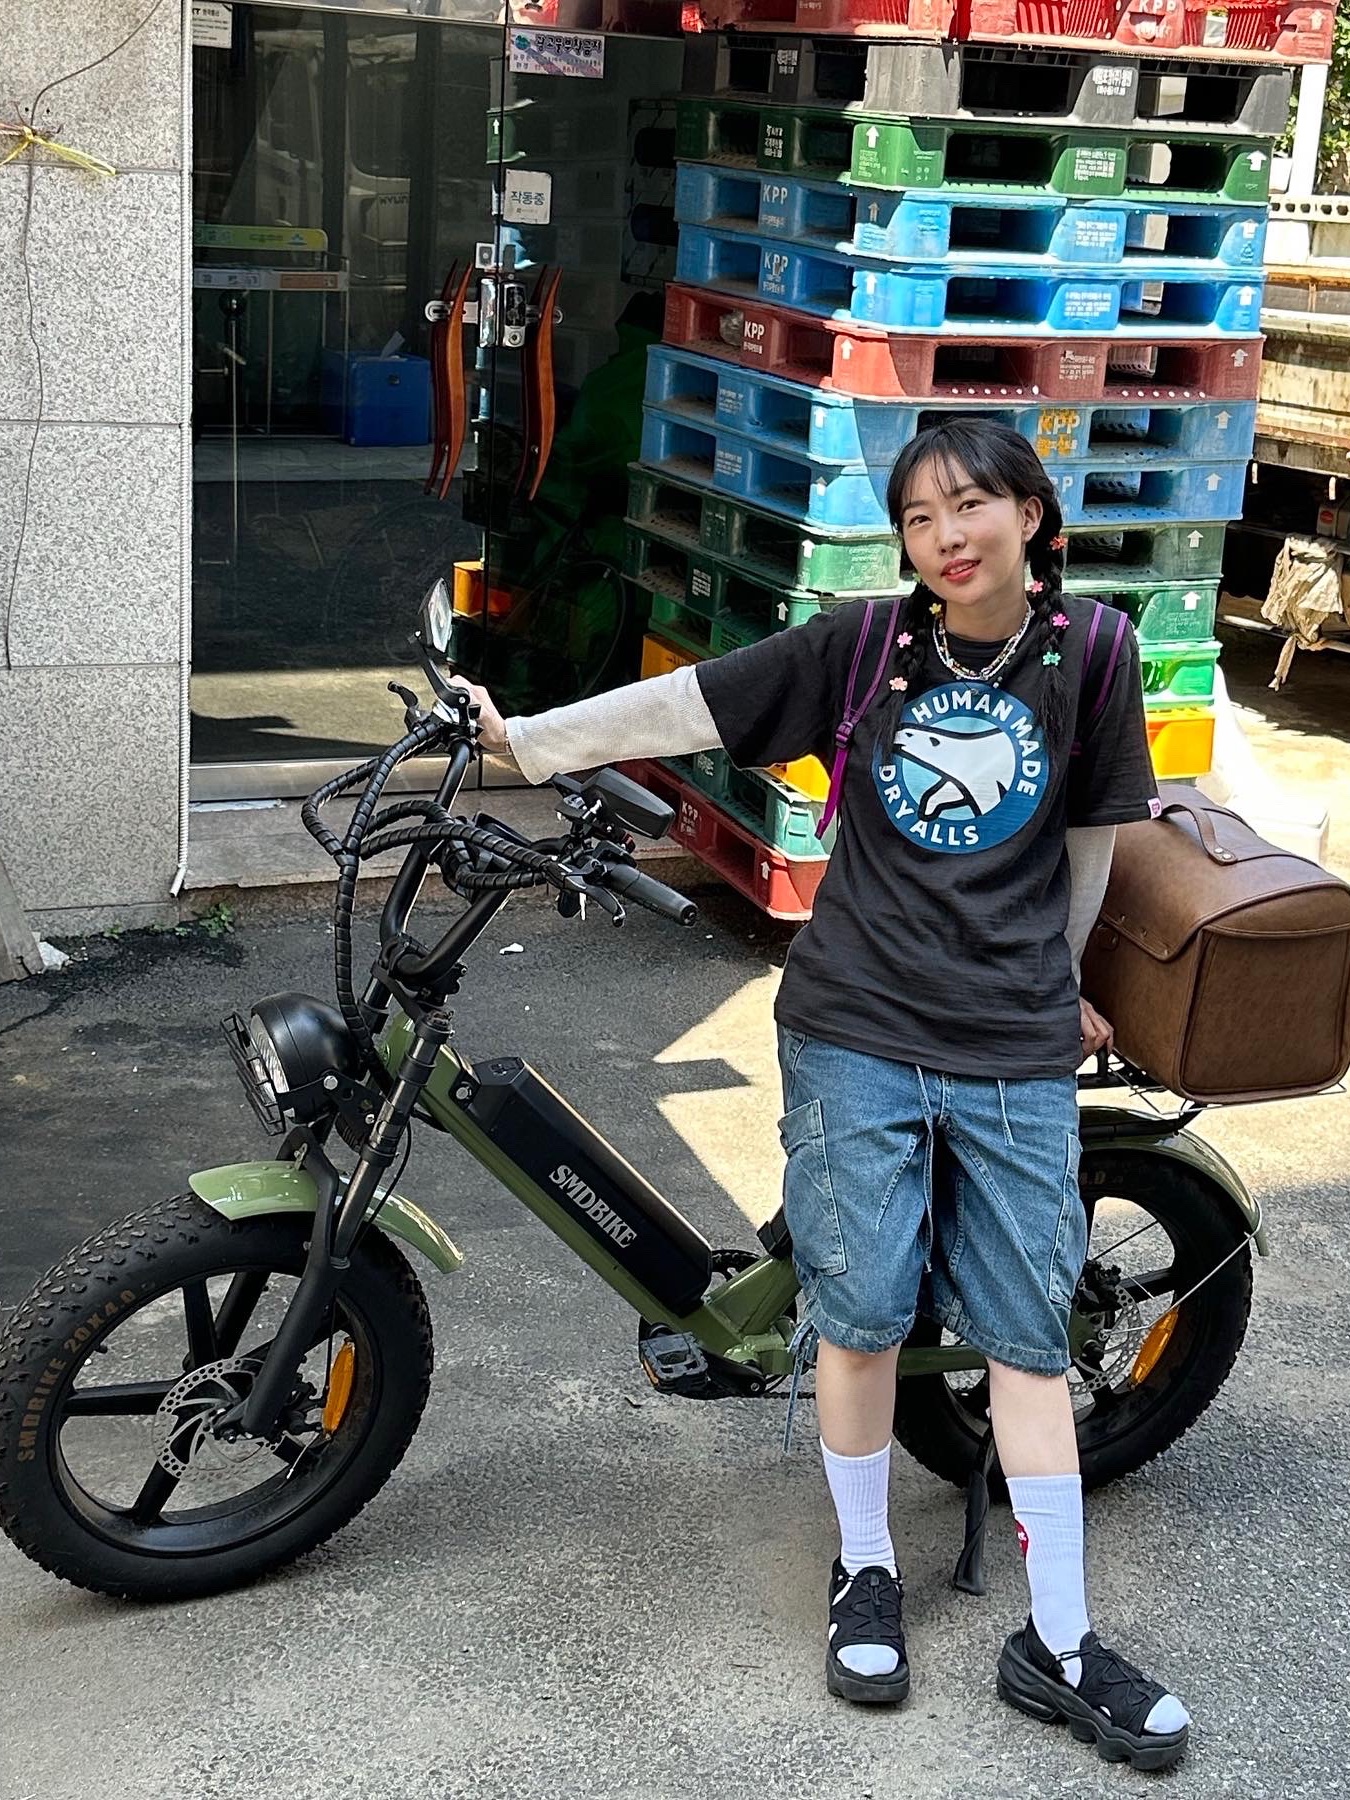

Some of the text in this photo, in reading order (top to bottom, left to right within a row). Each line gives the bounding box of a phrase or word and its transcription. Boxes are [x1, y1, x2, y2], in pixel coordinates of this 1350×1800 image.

[511, 191, 545, 206] 작동중
[763, 184, 788, 205] KPP
[764, 252, 789, 275] KPP
[744, 321, 765, 340] KPP
[911, 690, 1042, 797] HUMAN MADE
[682, 801, 699, 821] KPP
[878, 764, 980, 846] DRY ALLS
[548, 1164, 638, 1249] SMDBIKE
[17, 1358, 67, 1462] SMDBIKE
